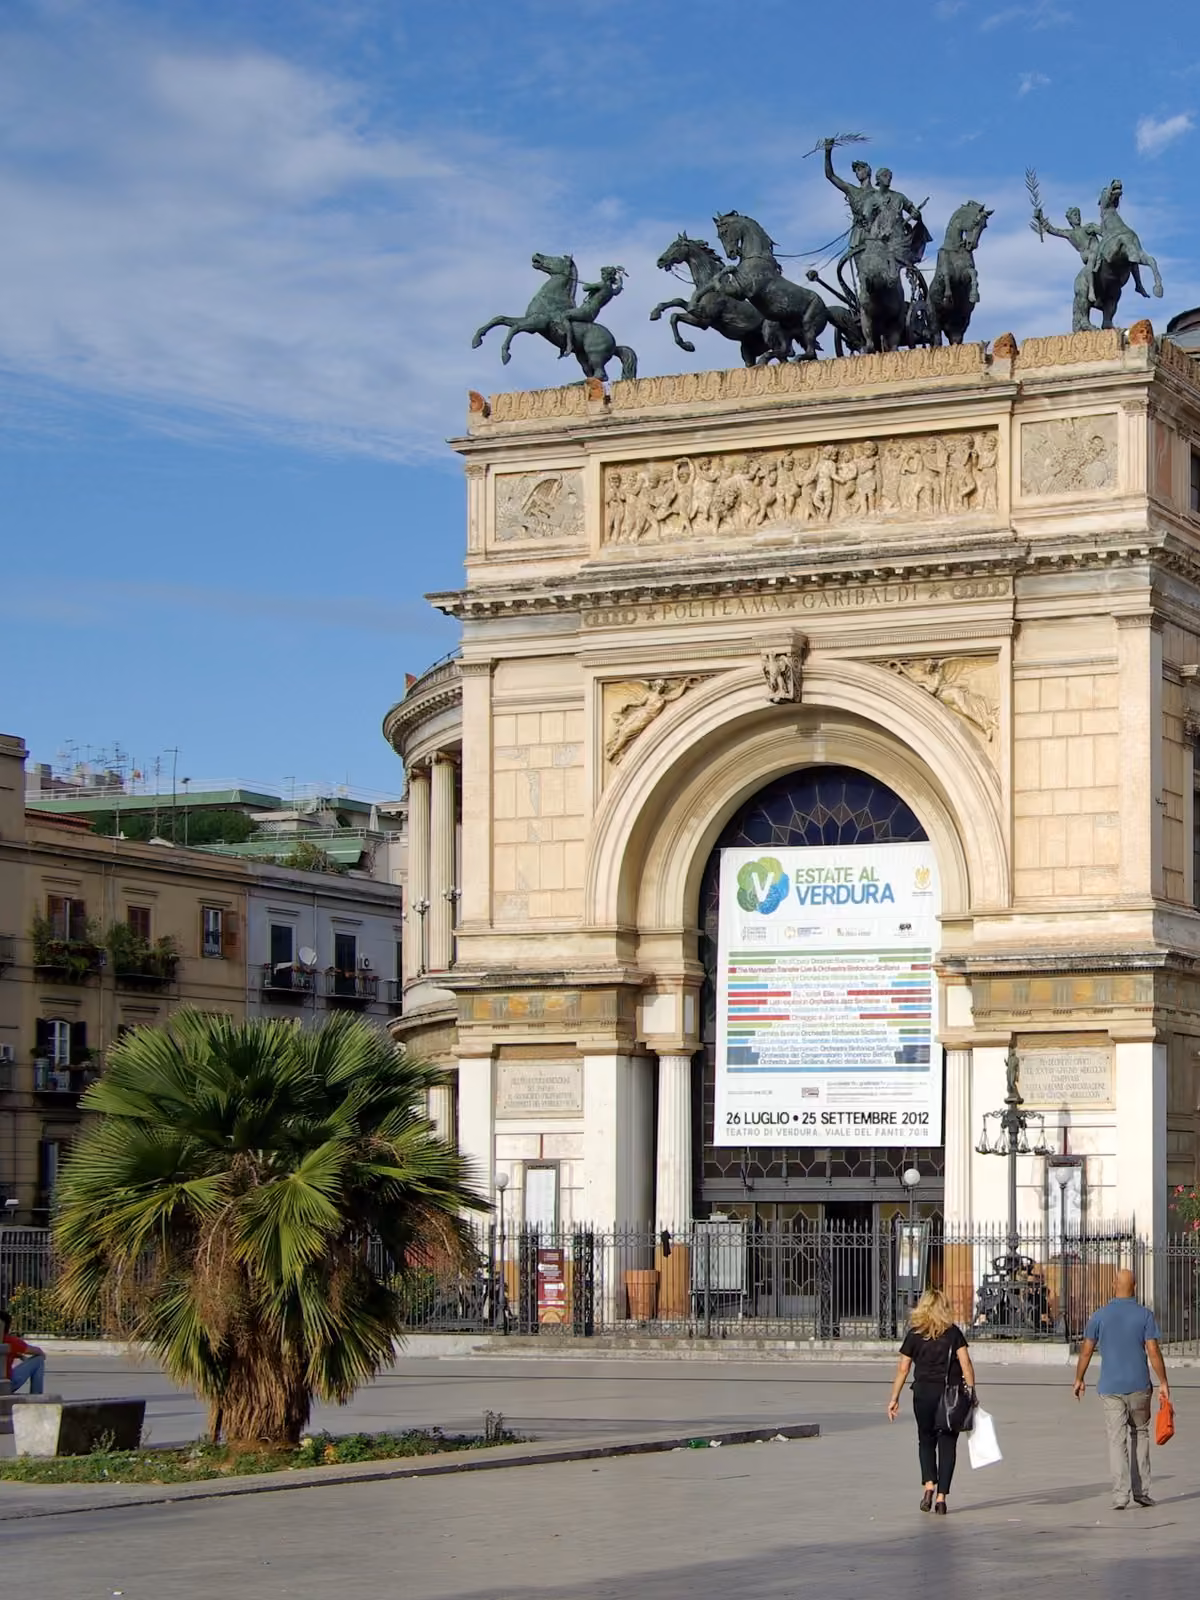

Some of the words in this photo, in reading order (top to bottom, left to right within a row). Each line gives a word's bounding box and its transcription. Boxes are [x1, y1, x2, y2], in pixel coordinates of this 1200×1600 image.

[662, 596, 781, 620] POLITEAMA
[802, 584, 917, 609] GARIBALDI
[796, 867, 853, 884] ESTATE
[858, 866, 880, 882] AL
[751, 872, 775, 903] V
[796, 883, 895, 905] VERDURA
[726, 1112, 740, 1125] 26
[744, 1112, 790, 1125] LUGLIO
[802, 1112, 817, 1125] 25
[820, 1112, 897, 1125] SETTEMBRE
[902, 1112, 929, 1125] 2012
[726, 1128, 760, 1136] TEATRO
[764, 1128, 773, 1136] DI
[825, 1128, 851, 1136] VIALE
[855, 1128, 872, 1136] DEL
